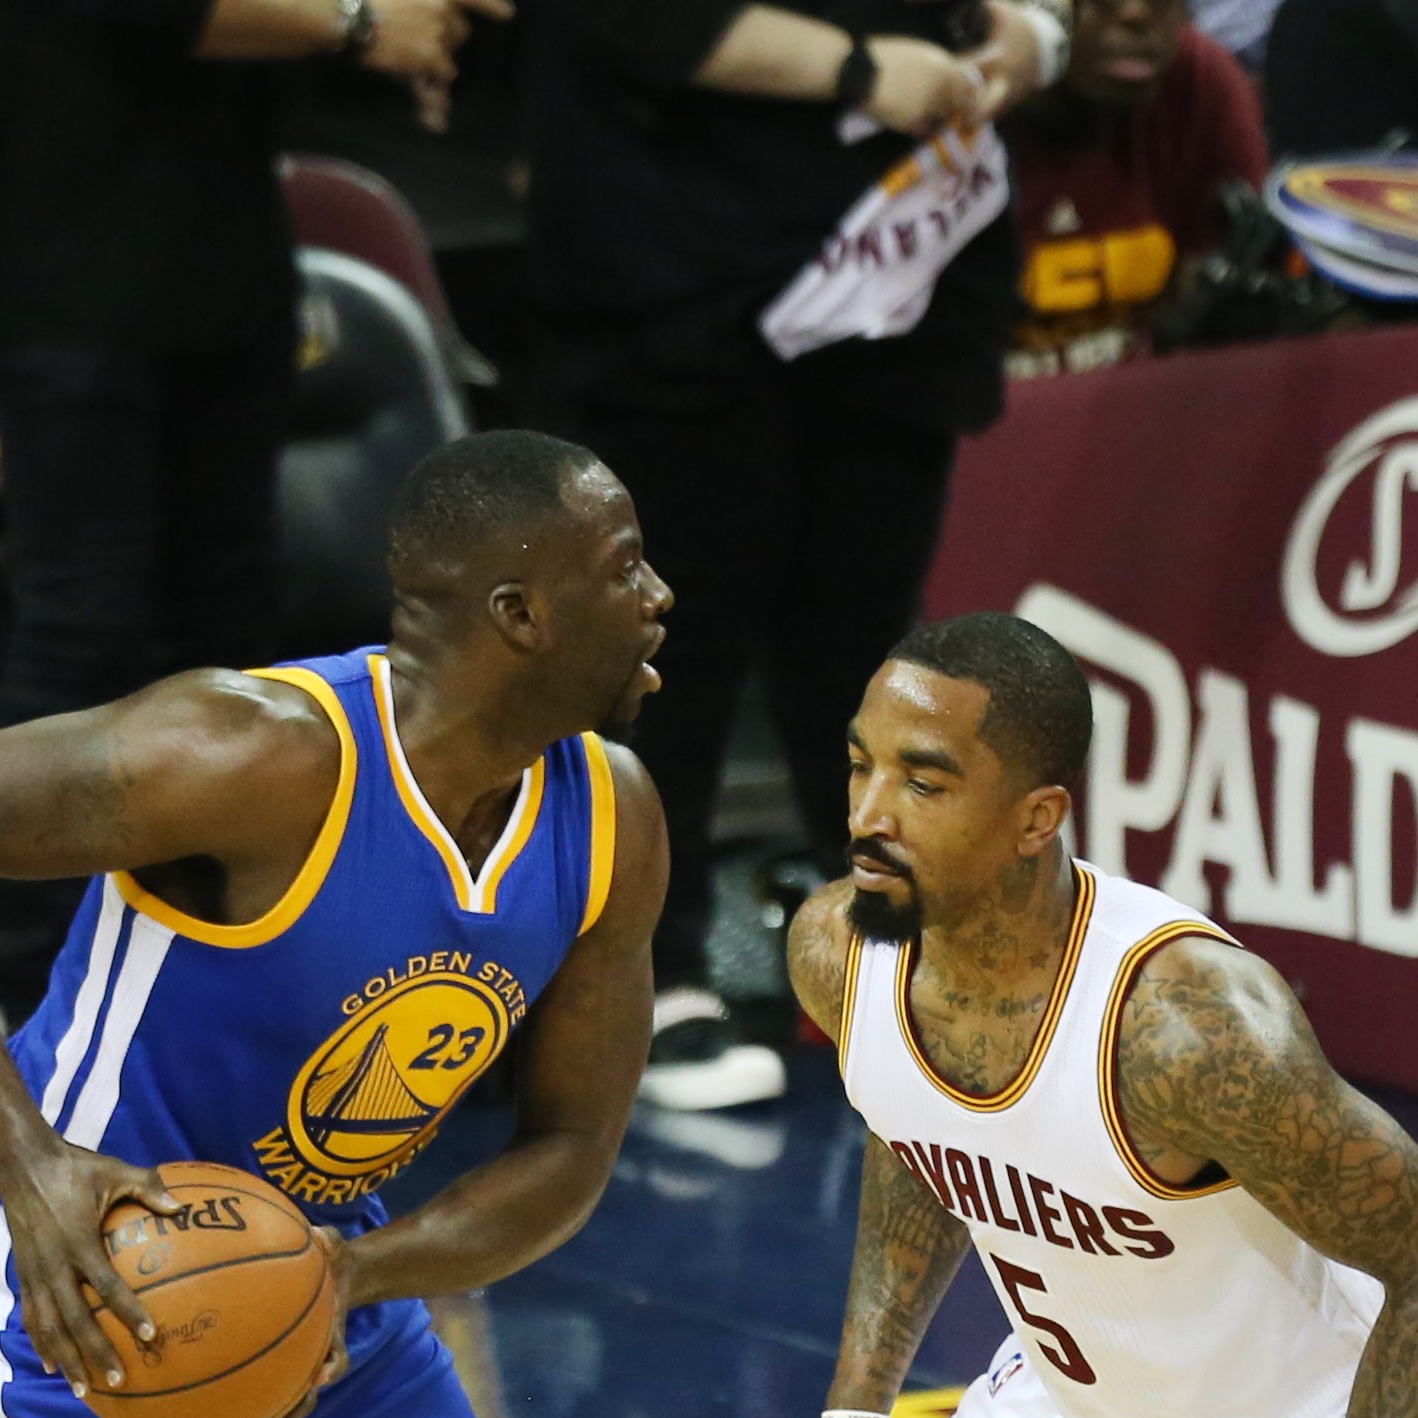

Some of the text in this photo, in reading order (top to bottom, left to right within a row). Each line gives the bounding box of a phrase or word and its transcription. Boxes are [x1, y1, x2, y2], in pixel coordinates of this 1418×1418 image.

[341, 951, 528, 1027] GOLDEN STATE
[408, 1023, 486, 1070] 23
[252, 1126, 439, 1205] WARRIO
[889, 1140, 1176, 1260] AVALIERS
[989, 1252, 1098, 1386] 5
